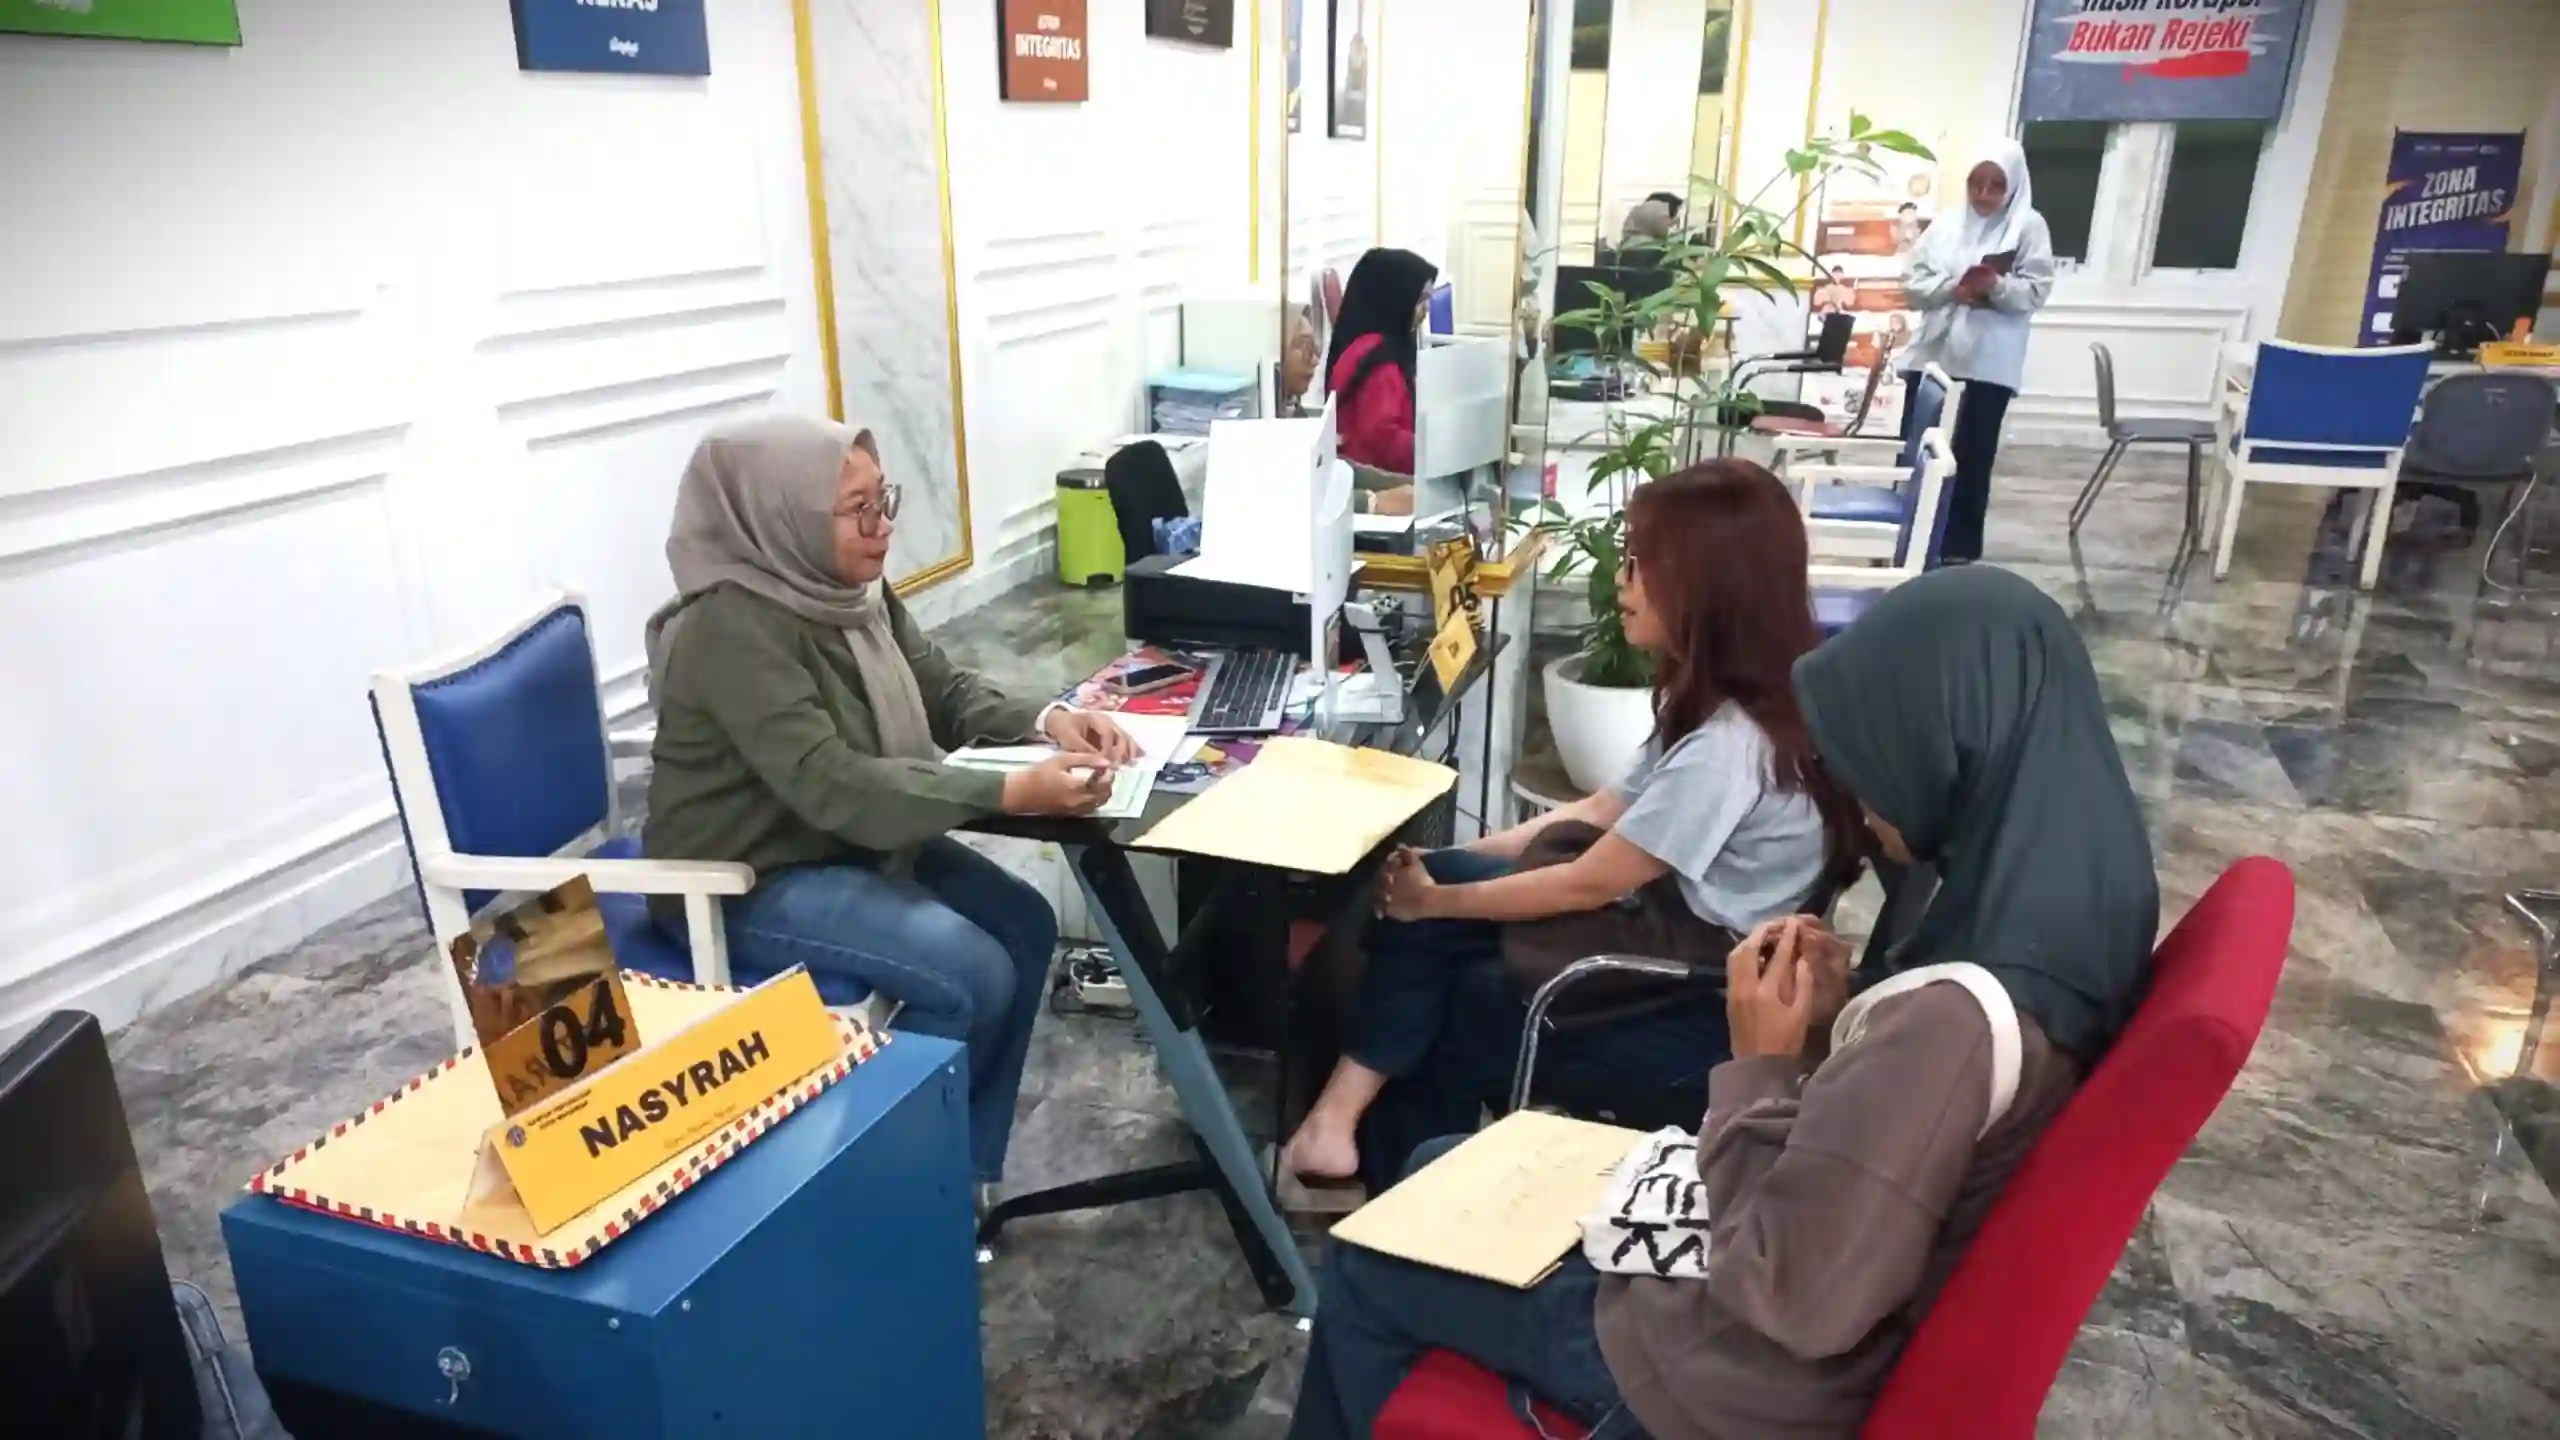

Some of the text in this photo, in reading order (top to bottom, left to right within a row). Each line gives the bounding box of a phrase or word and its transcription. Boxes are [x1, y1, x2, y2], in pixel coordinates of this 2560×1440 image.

[2068, 15, 2252, 52] Bukan Rejeki
[2421, 166, 2479, 199] ZONA
[2385, 188, 2506, 231] INTEGRITAS
[540, 980, 626, 1079] 04
[579, 1031, 771, 1159] NASYRAH
